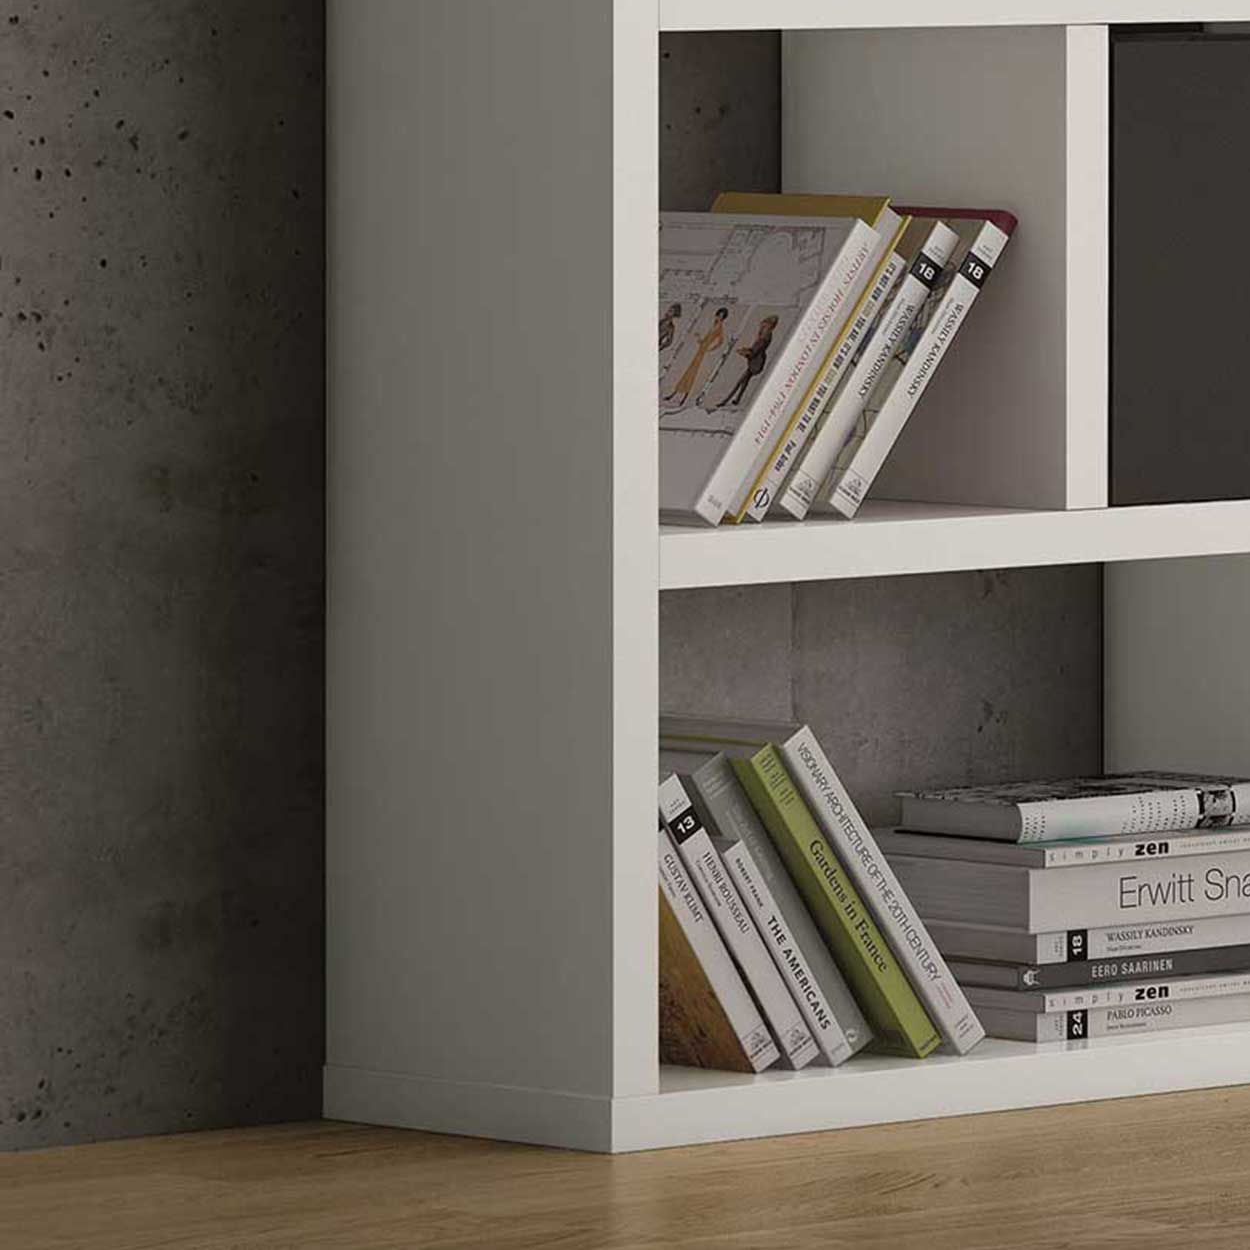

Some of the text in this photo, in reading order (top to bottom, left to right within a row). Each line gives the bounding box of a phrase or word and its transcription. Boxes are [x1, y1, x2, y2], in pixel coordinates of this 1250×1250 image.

[915, 261, 936, 281] 18
[964, 260, 985, 279] 18
[854, 302, 916, 399] WASSILY KANDINSKY
[905, 301, 965, 398] WASSILY KANDINSKY
[674, 814, 696, 834] 13
[1135, 840, 1169, 857] zen
[795, 741, 941, 983] VISIONARY ARCHITECTURE OF THE 20TH CENTURY
[661, 852, 706, 924] GUSTAV KLIMT
[699, 851, 752, 935] HENRI ROUSSEAU
[1119, 873, 1194, 909] Erwitt
[805, 837, 891, 974] Gardens in France
[1072, 934, 1083, 955] 18
[1106, 925, 1194, 942] WASSILY KANDINSKY
[764, 915, 835, 1031] THE AMERICANS
[1091, 959, 1173, 979] EERO SAARINEN
[1135, 986, 1170, 1001] zen
[1072, 1011, 1083, 1036] 24
[1107, 1005, 1172, 1021] PABLO PICASSO
